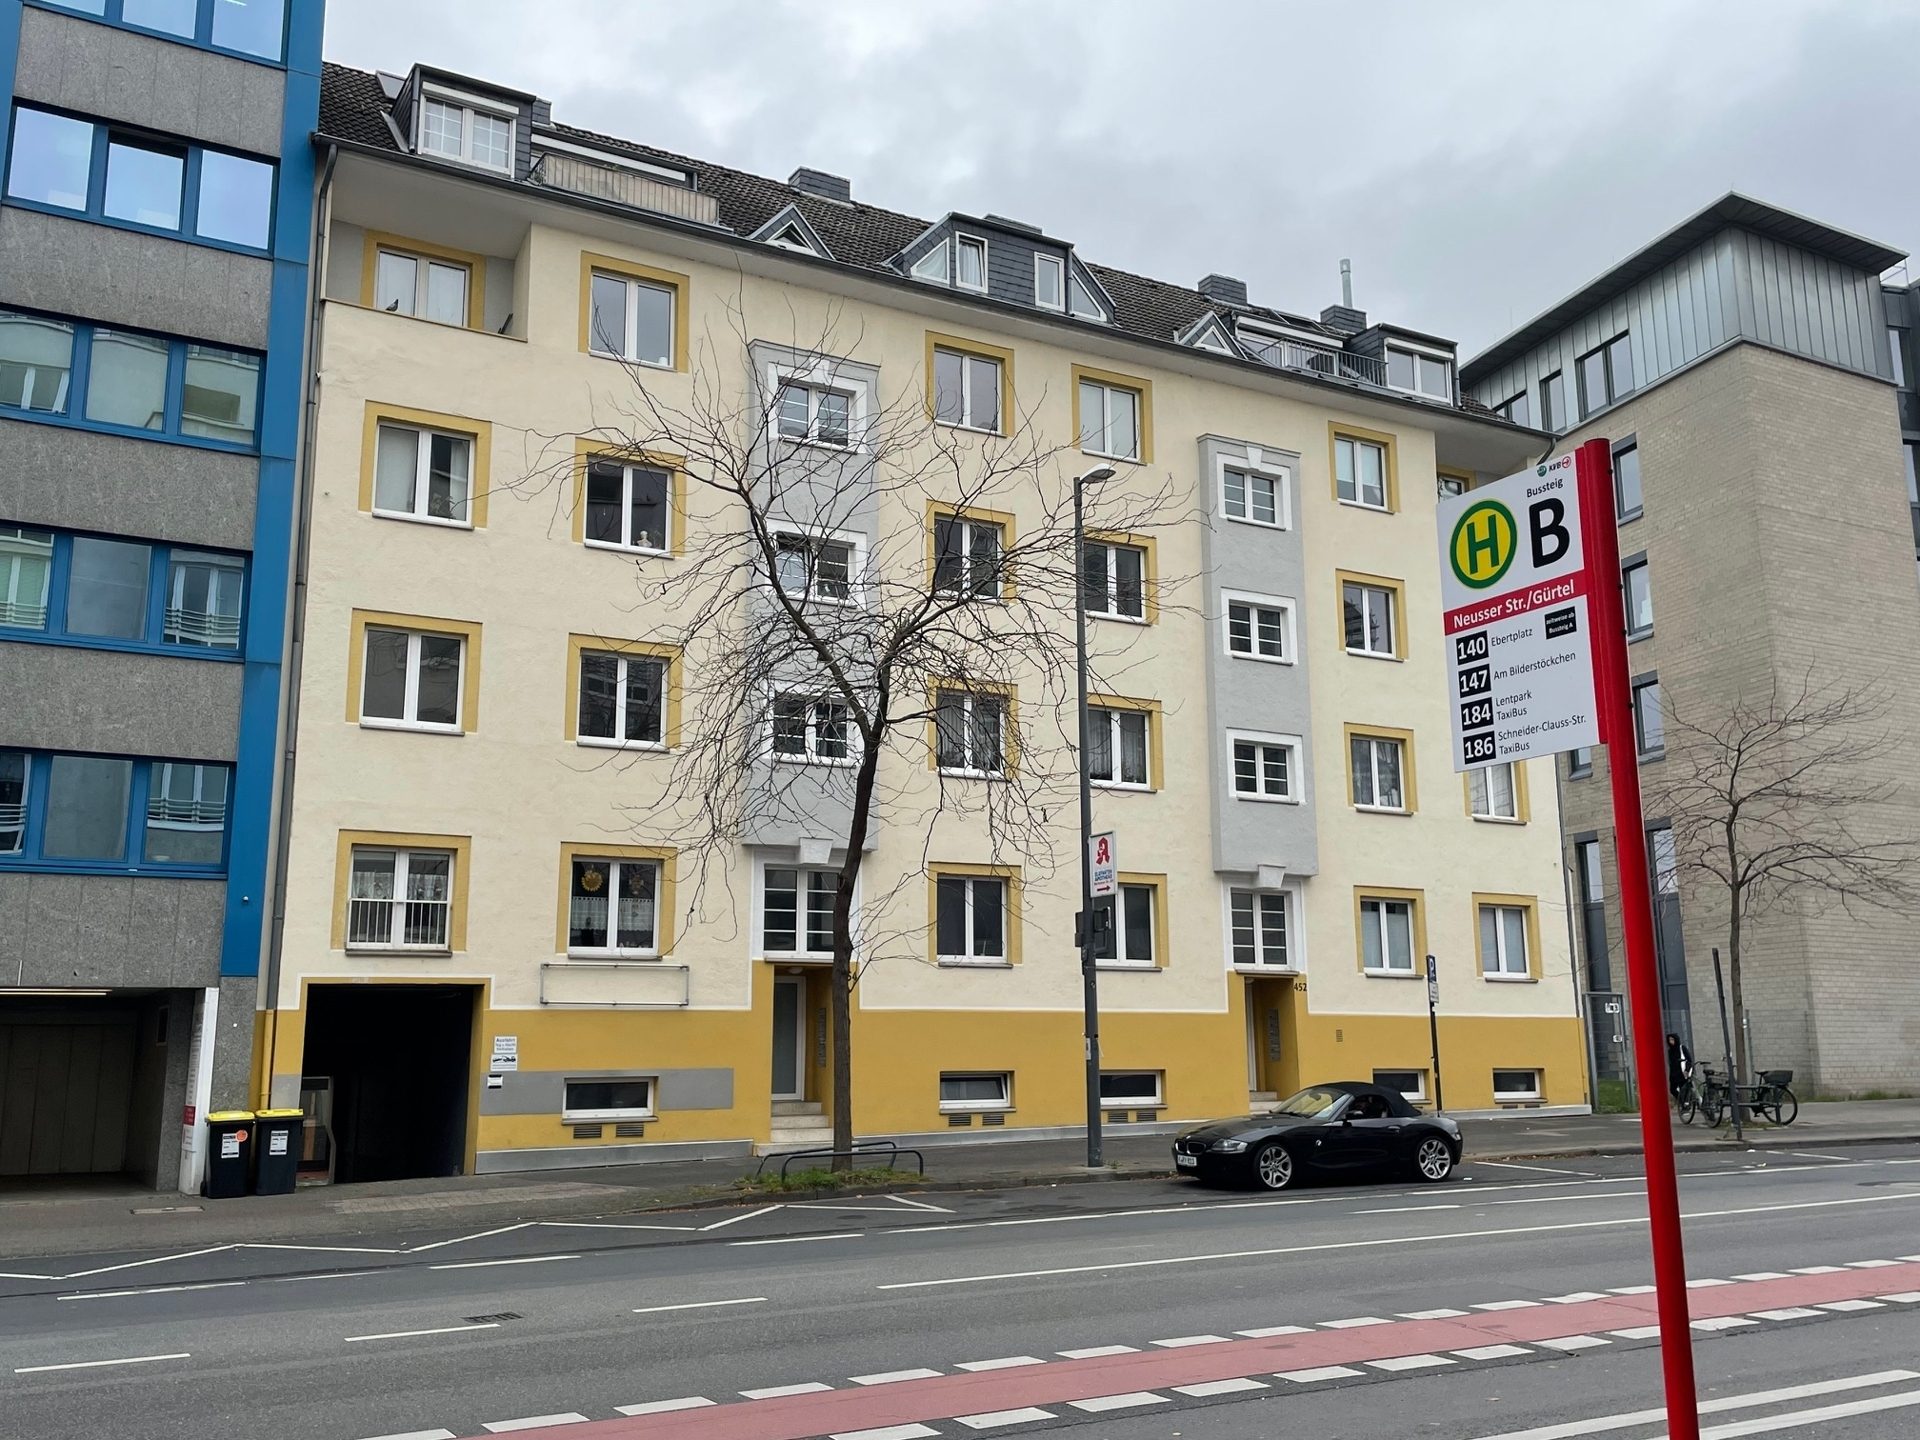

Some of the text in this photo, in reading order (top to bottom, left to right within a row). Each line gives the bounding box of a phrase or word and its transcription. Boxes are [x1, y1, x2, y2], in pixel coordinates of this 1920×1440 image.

[1526, 477, 1564, 498] Bussteig
[1466, 514, 1500, 575] H
[1529, 497, 1571, 569] B
[1453, 579, 1575, 628] Neusser Str./Gürtel
[1568, 612, 1575, 620] ab
[1457, 628, 1533, 660] 140 Ebertplatz
[1548, 624, 1569, 634] Bussteig
[1460, 651, 1576, 693] 147 Am Bilderstöckchen
[1462, 690, 1533, 726] 184 Lentpark
[1496, 706, 1528, 721] TaxiBus
[1464, 714, 1587, 759] 186 Schneider-Clauss-Str.
[1499, 741, 1530, 755] TaxiBus
[1293, 982, 1308, 992] 452
